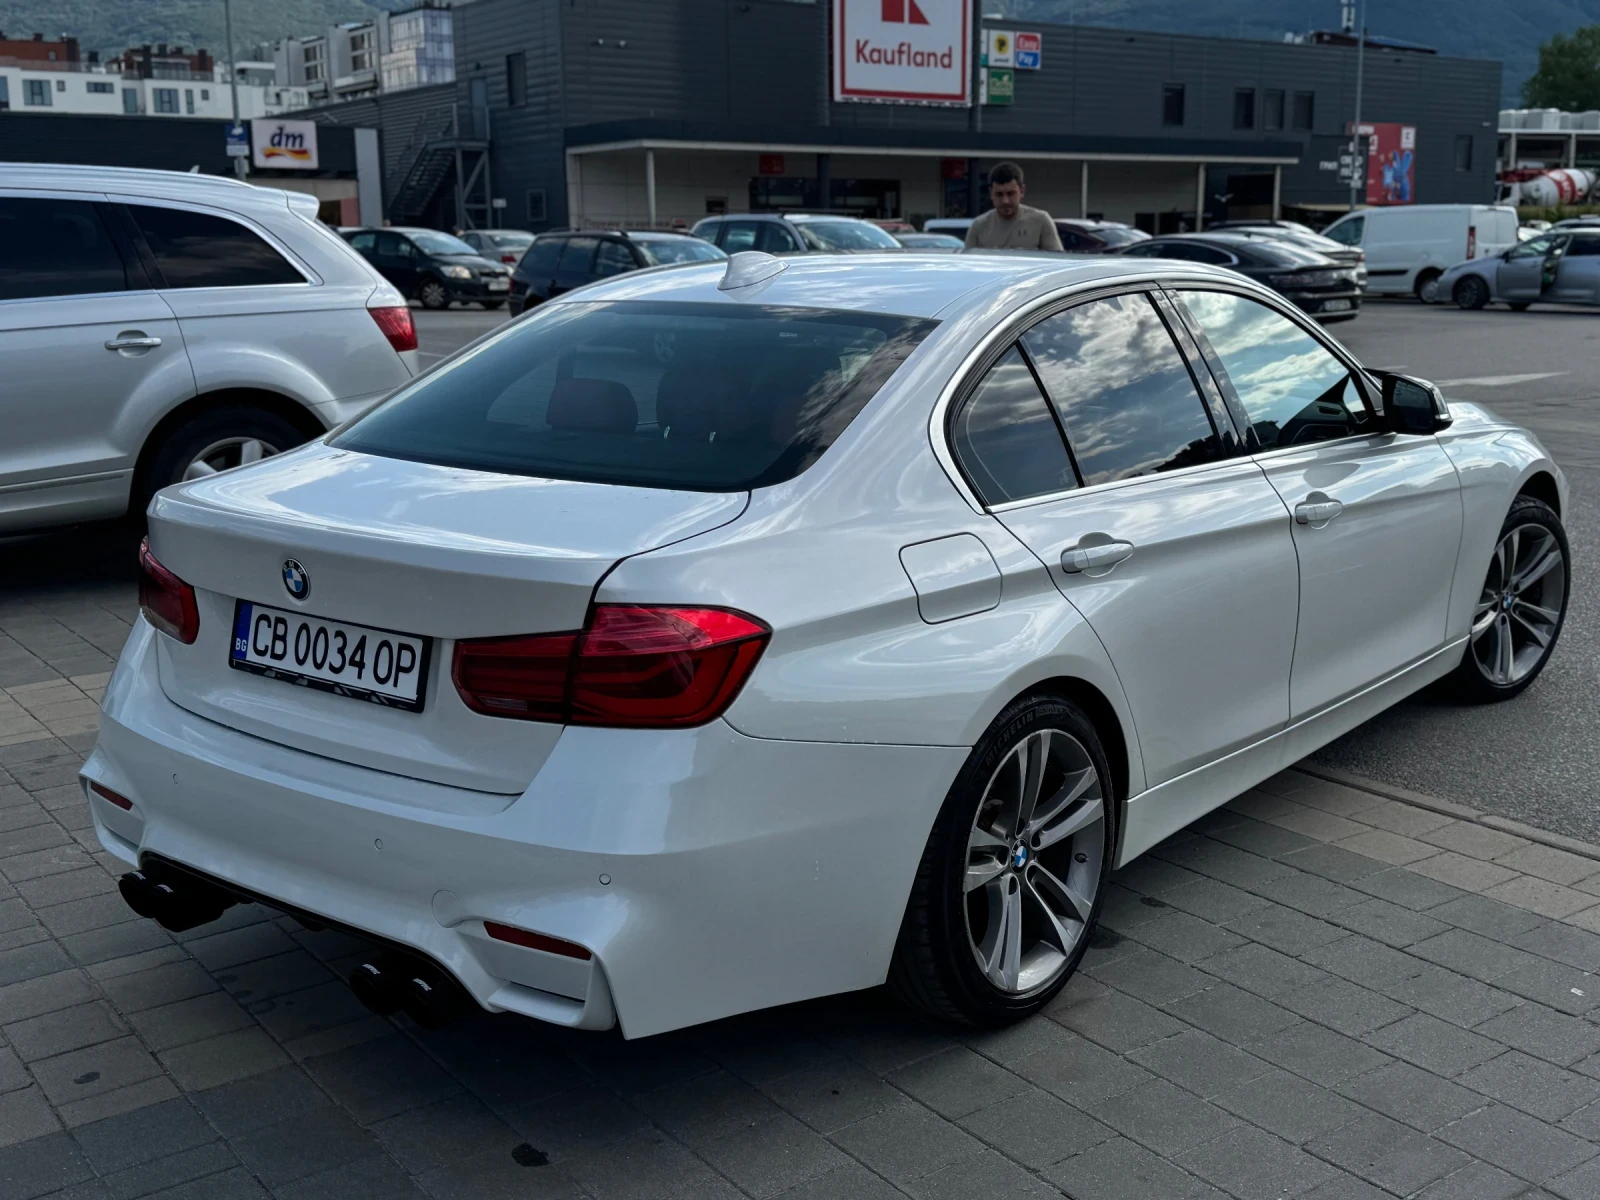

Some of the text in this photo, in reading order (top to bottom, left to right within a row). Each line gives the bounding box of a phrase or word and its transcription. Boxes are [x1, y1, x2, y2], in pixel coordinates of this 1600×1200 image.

[856, 39, 953, 69] Kaufland
[1019, 52, 1034, 66] Pay
[270, 126, 304, 148] dm
[235, 638, 248, 652] BG
[253, 613, 288, 661] CB
[294, 622, 367, 680] 0034
[985, 711, 1035, 767] MICHELIN
